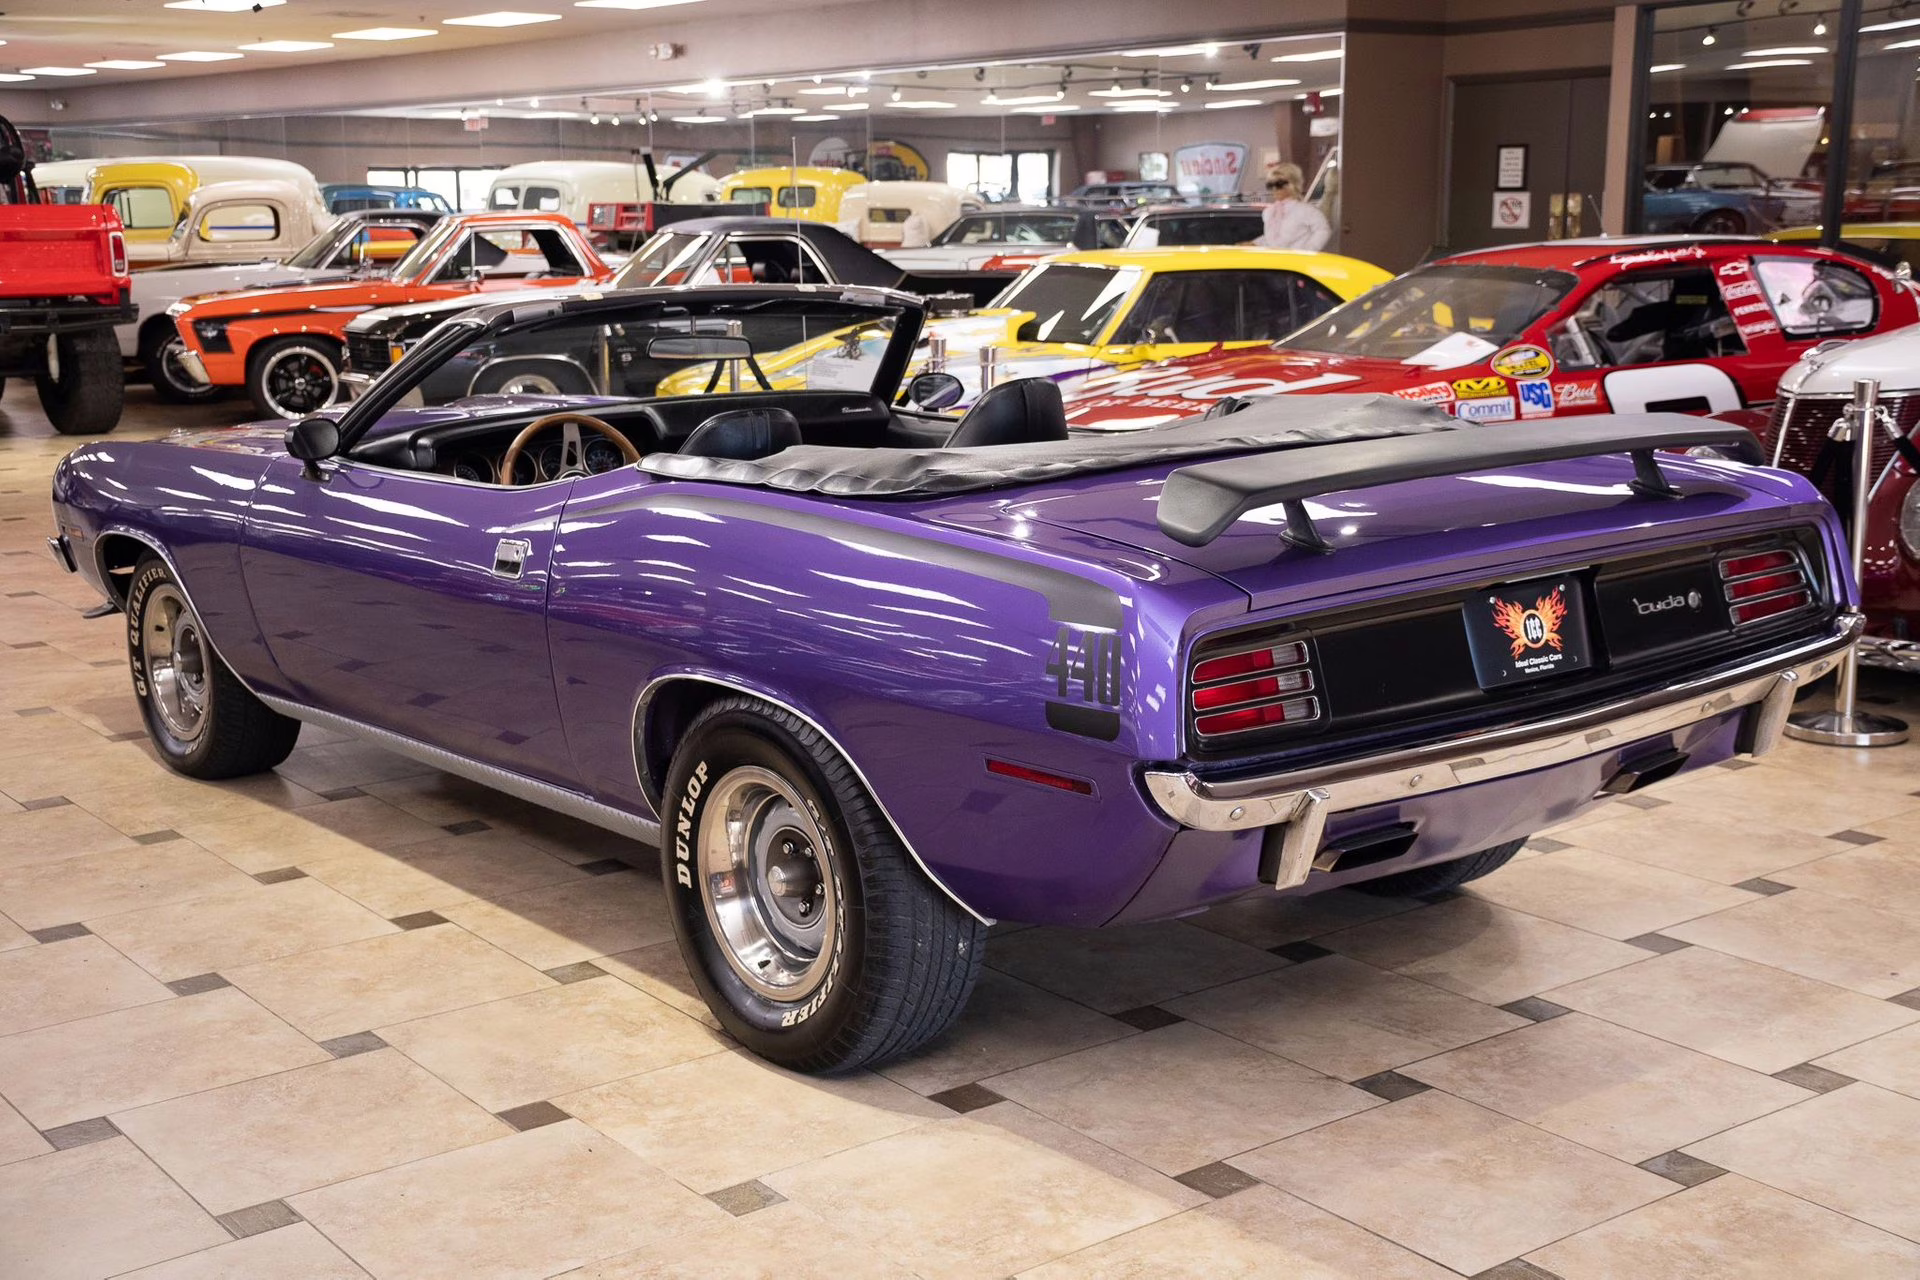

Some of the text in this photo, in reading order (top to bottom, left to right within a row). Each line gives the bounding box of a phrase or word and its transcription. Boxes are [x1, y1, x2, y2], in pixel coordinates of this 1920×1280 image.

[1520, 383, 1552, 408] USG
[1554, 382, 1598, 403] Bud
[1457, 400, 1512, 419] Commit
[131, 568, 167, 697] G/T QUALIFIER
[1045, 627, 1121, 706] 440
[1515, 660, 1529, 668] Ideal
[1529, 656, 1549, 665] Classic
[676, 760, 709, 889] DUNLOP
